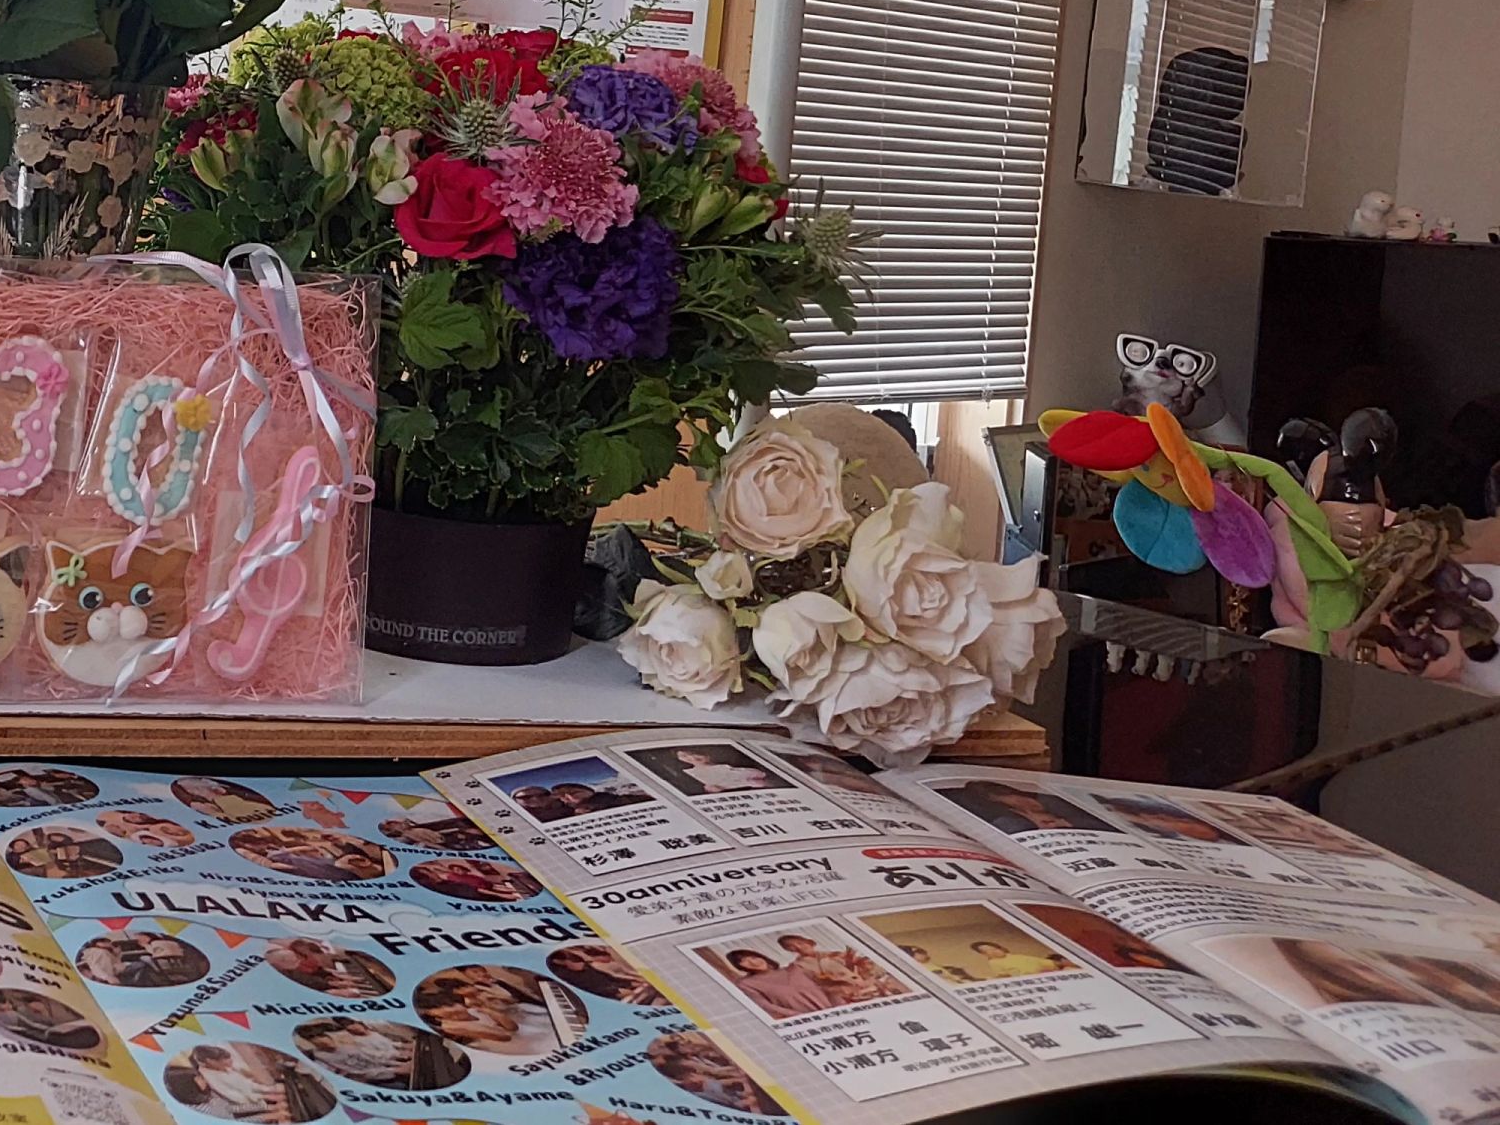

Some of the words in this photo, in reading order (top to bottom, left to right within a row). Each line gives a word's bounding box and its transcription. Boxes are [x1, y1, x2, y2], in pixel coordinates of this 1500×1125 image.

[418, 626, 449, 643] THE
[452, 629, 518, 645] CORNER
[729, 822, 789, 840] 吉川
[580, 855, 834, 911] 30anniversary
[110, 890, 387, 925] ULALAKA
[368, 917, 600, 957] Friends
[146, 953, 266, 1037] Yuzune&Suzuka
[252, 996, 407, 1017] Michiko&U
[801, 1030, 877, 1057] 小浦方
[822, 1048, 900, 1076] 小浦方
[339, 1087, 576, 1107] Sakuya&Ayame
